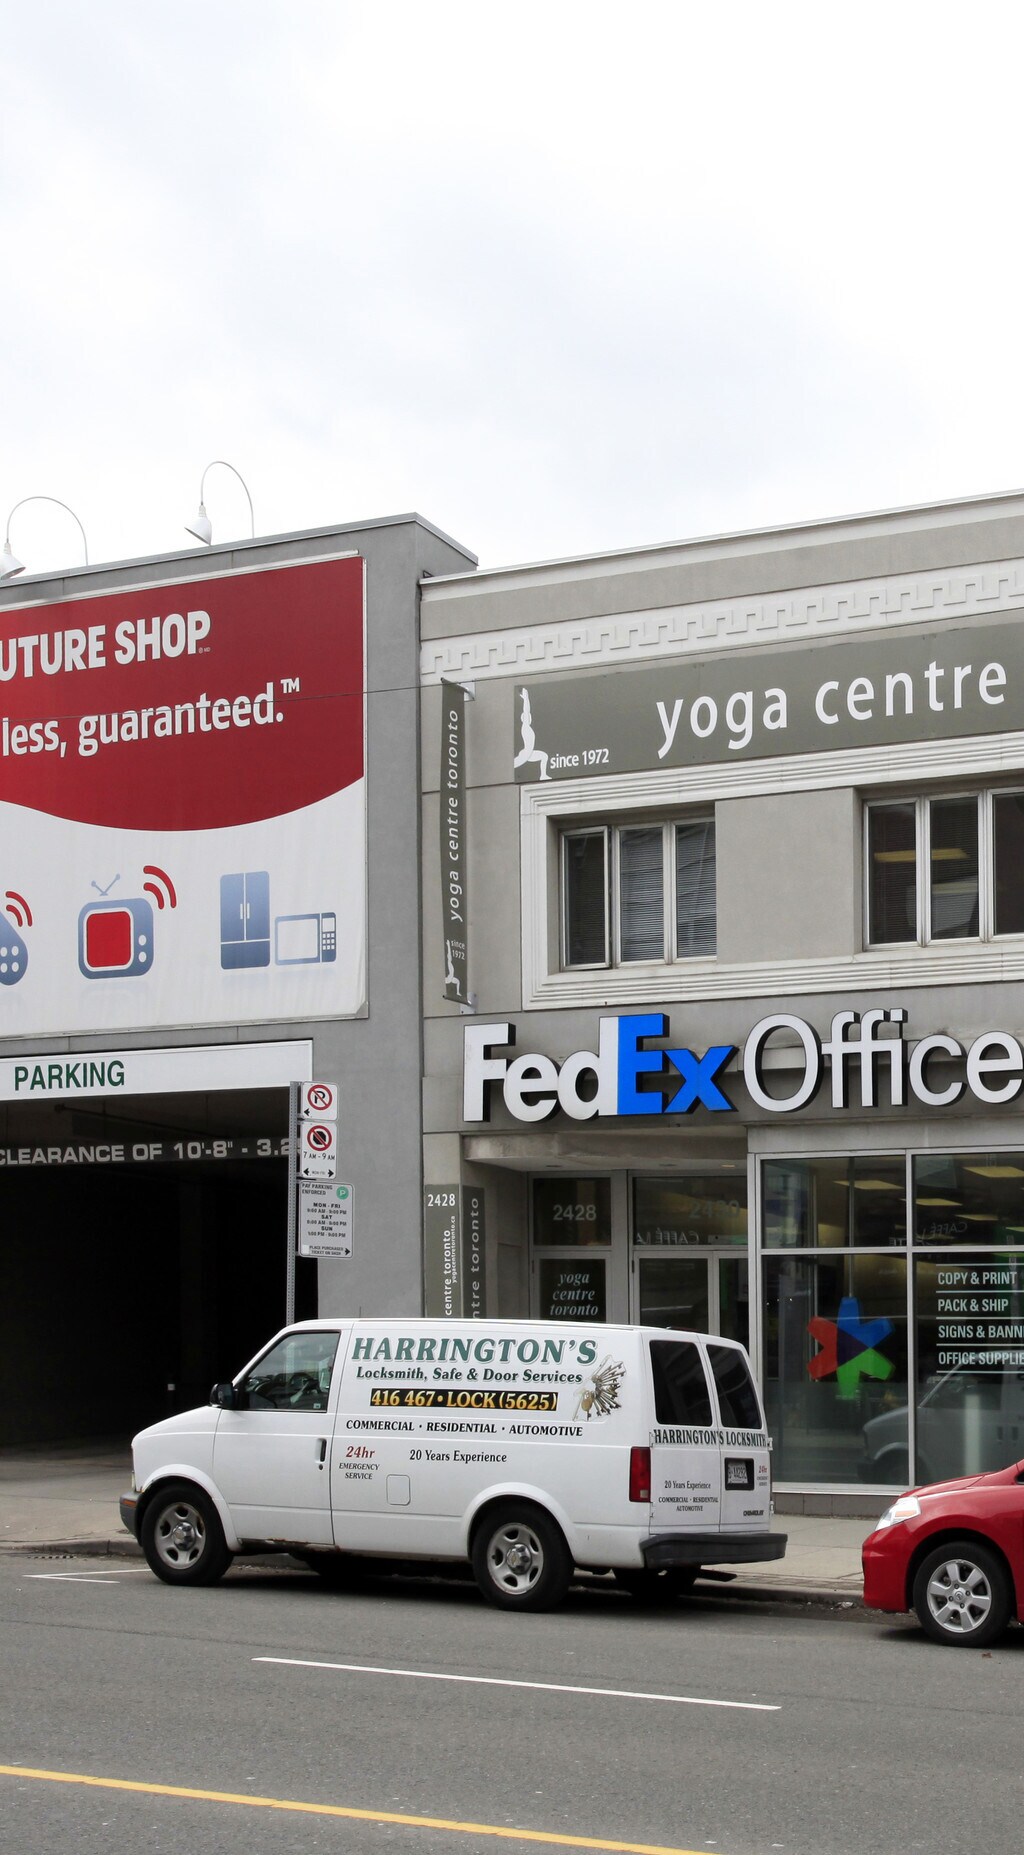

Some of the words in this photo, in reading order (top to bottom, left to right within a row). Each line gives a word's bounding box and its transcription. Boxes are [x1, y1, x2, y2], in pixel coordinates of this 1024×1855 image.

[114, 610, 211, 666] SHOP
[655, 688, 788, 758] yoga
[814, 657, 1006, 727] centre
[1, 717, 68, 758] less,
[446, 709, 459, 788] toronto
[549, 752, 579, 770] since
[581, 747, 609, 766] 1972
[446, 798, 459, 861] centre
[450, 871, 463, 922] yoga
[450, 939, 465, 950] since
[451, 949, 466, 960] 1972
[14, 1060, 125, 1091] PARKING
[463, 1012, 738, 1124] FedEx
[132, 1143, 162, 1161] OF
[303, 1151, 308, 1159] 7
[322, 1152, 327, 1160] 9
[427, 1193, 456, 1207] 2428
[553, 1204, 597, 1221] 2428
[470, 1198, 480, 1273] toronto
[558, 1272, 590, 1286] yoga
[938, 1271, 968, 1285] COPY
[970, 1272, 980, 1285] &
[982, 1271, 1017, 1285] PRINT
[444, 1278, 452, 1316] centre
[552, 1288, 596, 1302] centre
[549, 1303, 599, 1317] toronto
[937, 1299, 967, 1312] PACK
[970, 1299, 979, 1312] &
[982, 1298, 1009, 1311] SHIP
[938, 1325, 973, 1339] SIGNS
[975, 1325, 986, 1339] &
[350, 1337, 597, 1365] HARRINGTON'S
[938, 1352, 977, 1366] OFFICE
[356, 1366, 428, 1381] Locksmith,
[432, 1367, 462, 1380] Safe
[466, 1367, 478, 1380] &
[483, 1368, 518, 1381] Door
[522, 1369, 583, 1383] Services
[371, 1389, 400, 1406] 416
[498, 1391, 558, 1410] (5625)
[346, 1419, 415, 1432] COMMERCIAL
[426, 1421, 497, 1434] RESIDENTIAL
[509, 1424, 583, 1437] AUTOMOTIVE
[653, 1429, 724, 1444] HARRINGTON'S
[345, 1445, 375, 1459] 24hr
[409, 1449, 422, 1461] 20
[425, 1449, 450, 1462] Years
[453, 1450, 507, 1464] Experience
[339, 1462, 380, 1471] EMERGENCY
[344, 1472, 373, 1480] SERVICE
[664, 1480, 672, 1489] 20
[673, 1480, 686, 1489] Years
[686, 1481, 711, 1491] Experience
